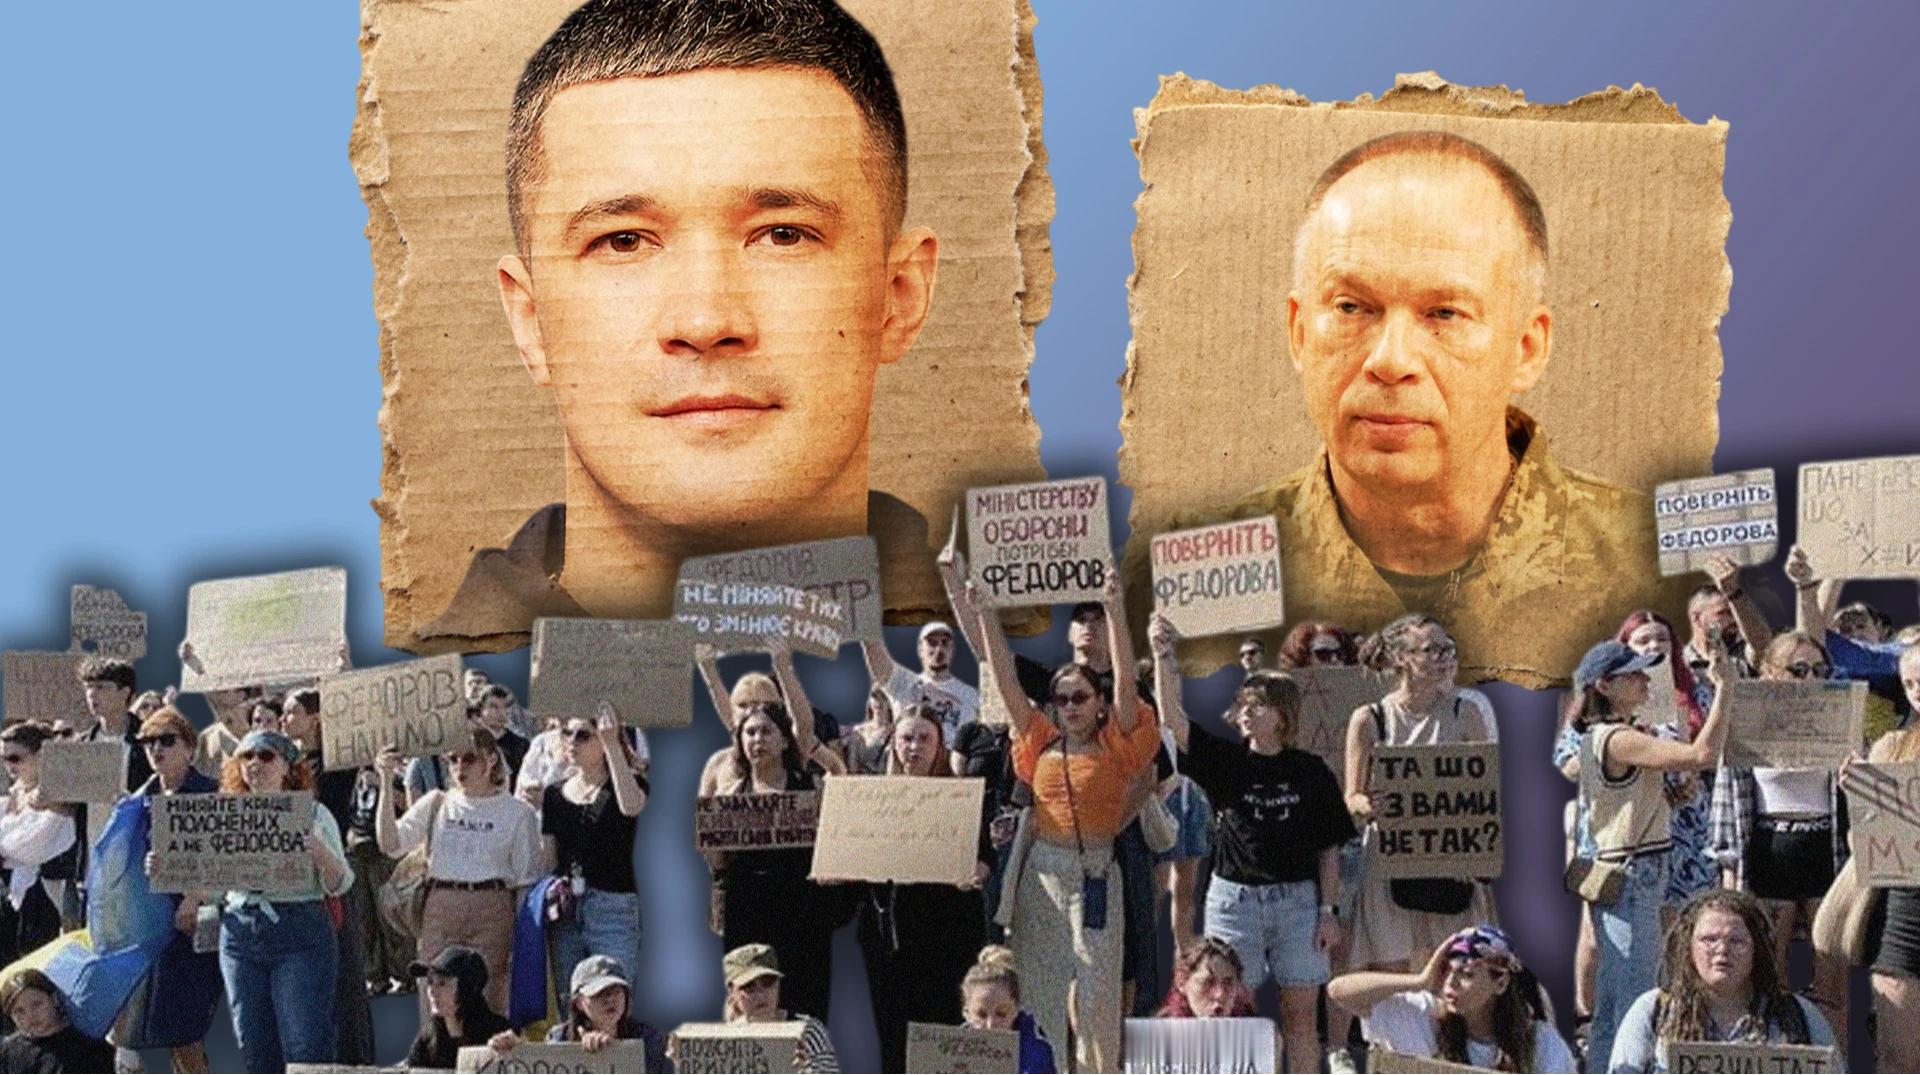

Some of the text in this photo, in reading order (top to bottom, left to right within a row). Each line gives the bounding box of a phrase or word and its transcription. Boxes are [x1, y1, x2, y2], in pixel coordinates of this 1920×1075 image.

[976, 483, 1101, 516] МІНІСТЕРСТВУ
[1657, 487, 1771, 513] ПОВЕРНІТЬ
[984, 514, 1089, 544] ОБОРОНИ
[1660, 523, 1776, 548] ФЕДОРОВА
[1154, 527, 1277, 566] ПОВЕРНІТЬ
[982, 559, 1105, 596] ФЕДОРОВ
[1154, 559, 1279, 607] ФЕДОРОВА
[683, 584, 718, 604] НЕ
[1379, 756, 1486, 779] ТА ШО
[1384, 790, 1497, 817] З ВАМИ
[169, 813, 280, 834] ПОЛОНЕНИХ
[210, 831, 307, 855] ФЕДОРОВА
[1379, 821, 1499, 855] НЕ ТАК?
